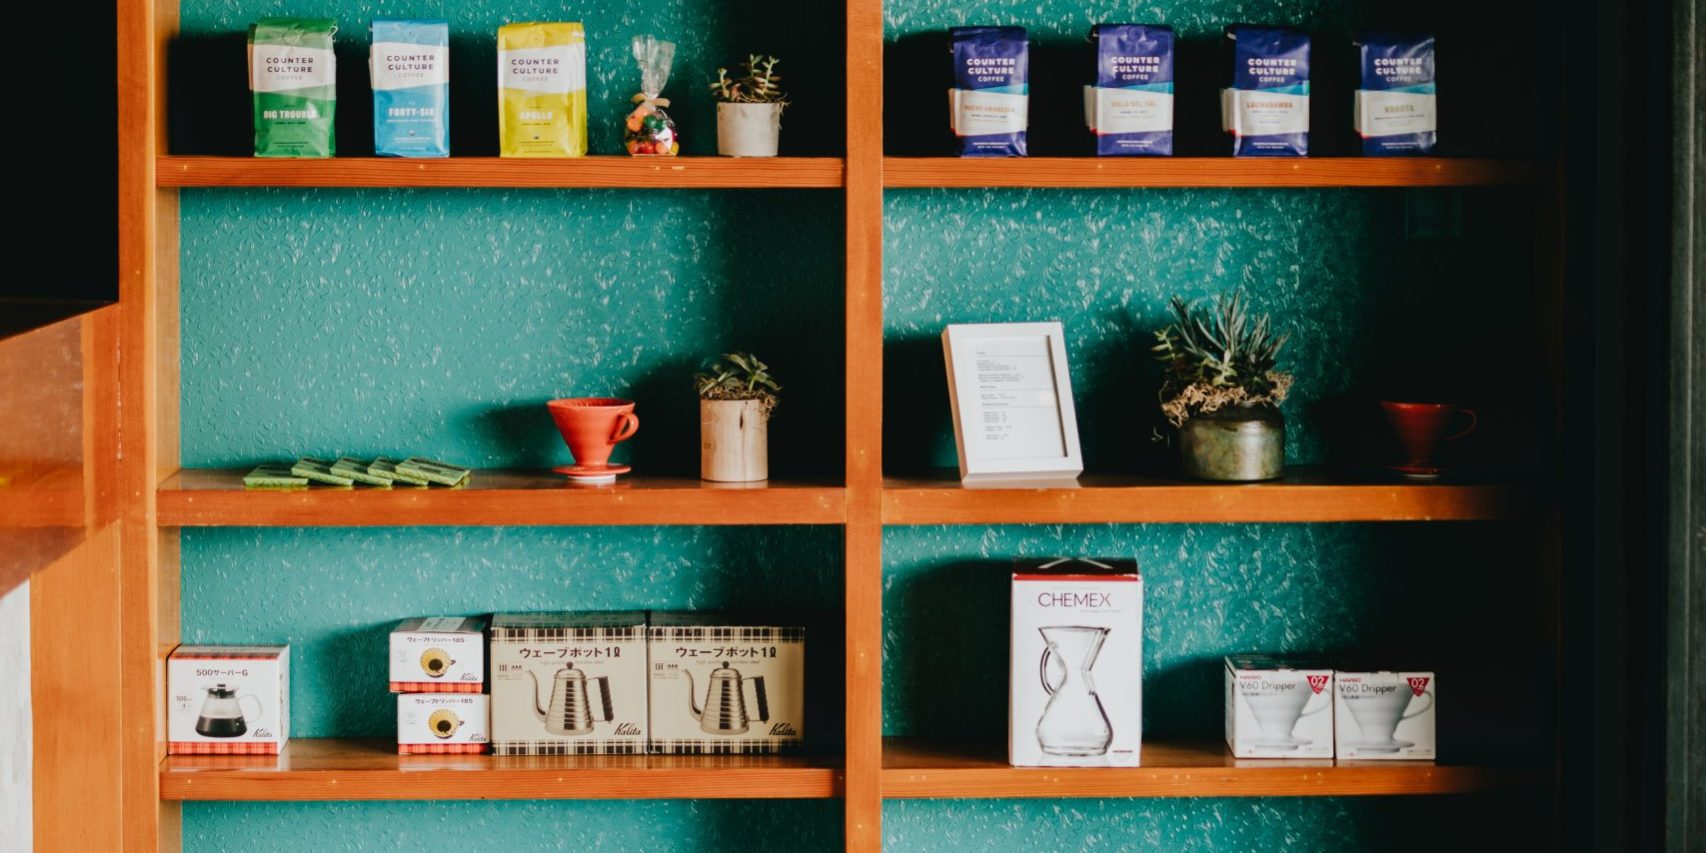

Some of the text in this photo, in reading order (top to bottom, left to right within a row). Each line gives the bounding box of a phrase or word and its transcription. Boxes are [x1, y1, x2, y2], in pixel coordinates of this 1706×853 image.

[511, 58, 559, 66] COUNTER
[966, 58, 1016, 66] COUNTER
[1111, 56, 1160, 64] COUNTER
[1247, 58, 1297, 67] COUNTER
[967, 67, 1015, 75] CULTURE
[1375, 67, 1422, 75] CULTURE
[280, 110, 318, 119] TROUBL
[388, 107, 434, 117] FORTY-SIX
[1038, 592, 1111, 607] CHEMEX
[1311, 676, 1325, 686] 02
[1411, 679, 1425, 689] 02
[1240, 681, 1296, 692] V60 Dripper
[1339, 684, 1397, 695] V60 Dripper
[614, 723, 641, 736] Kalita
[769, 723, 796, 736] Kalita
